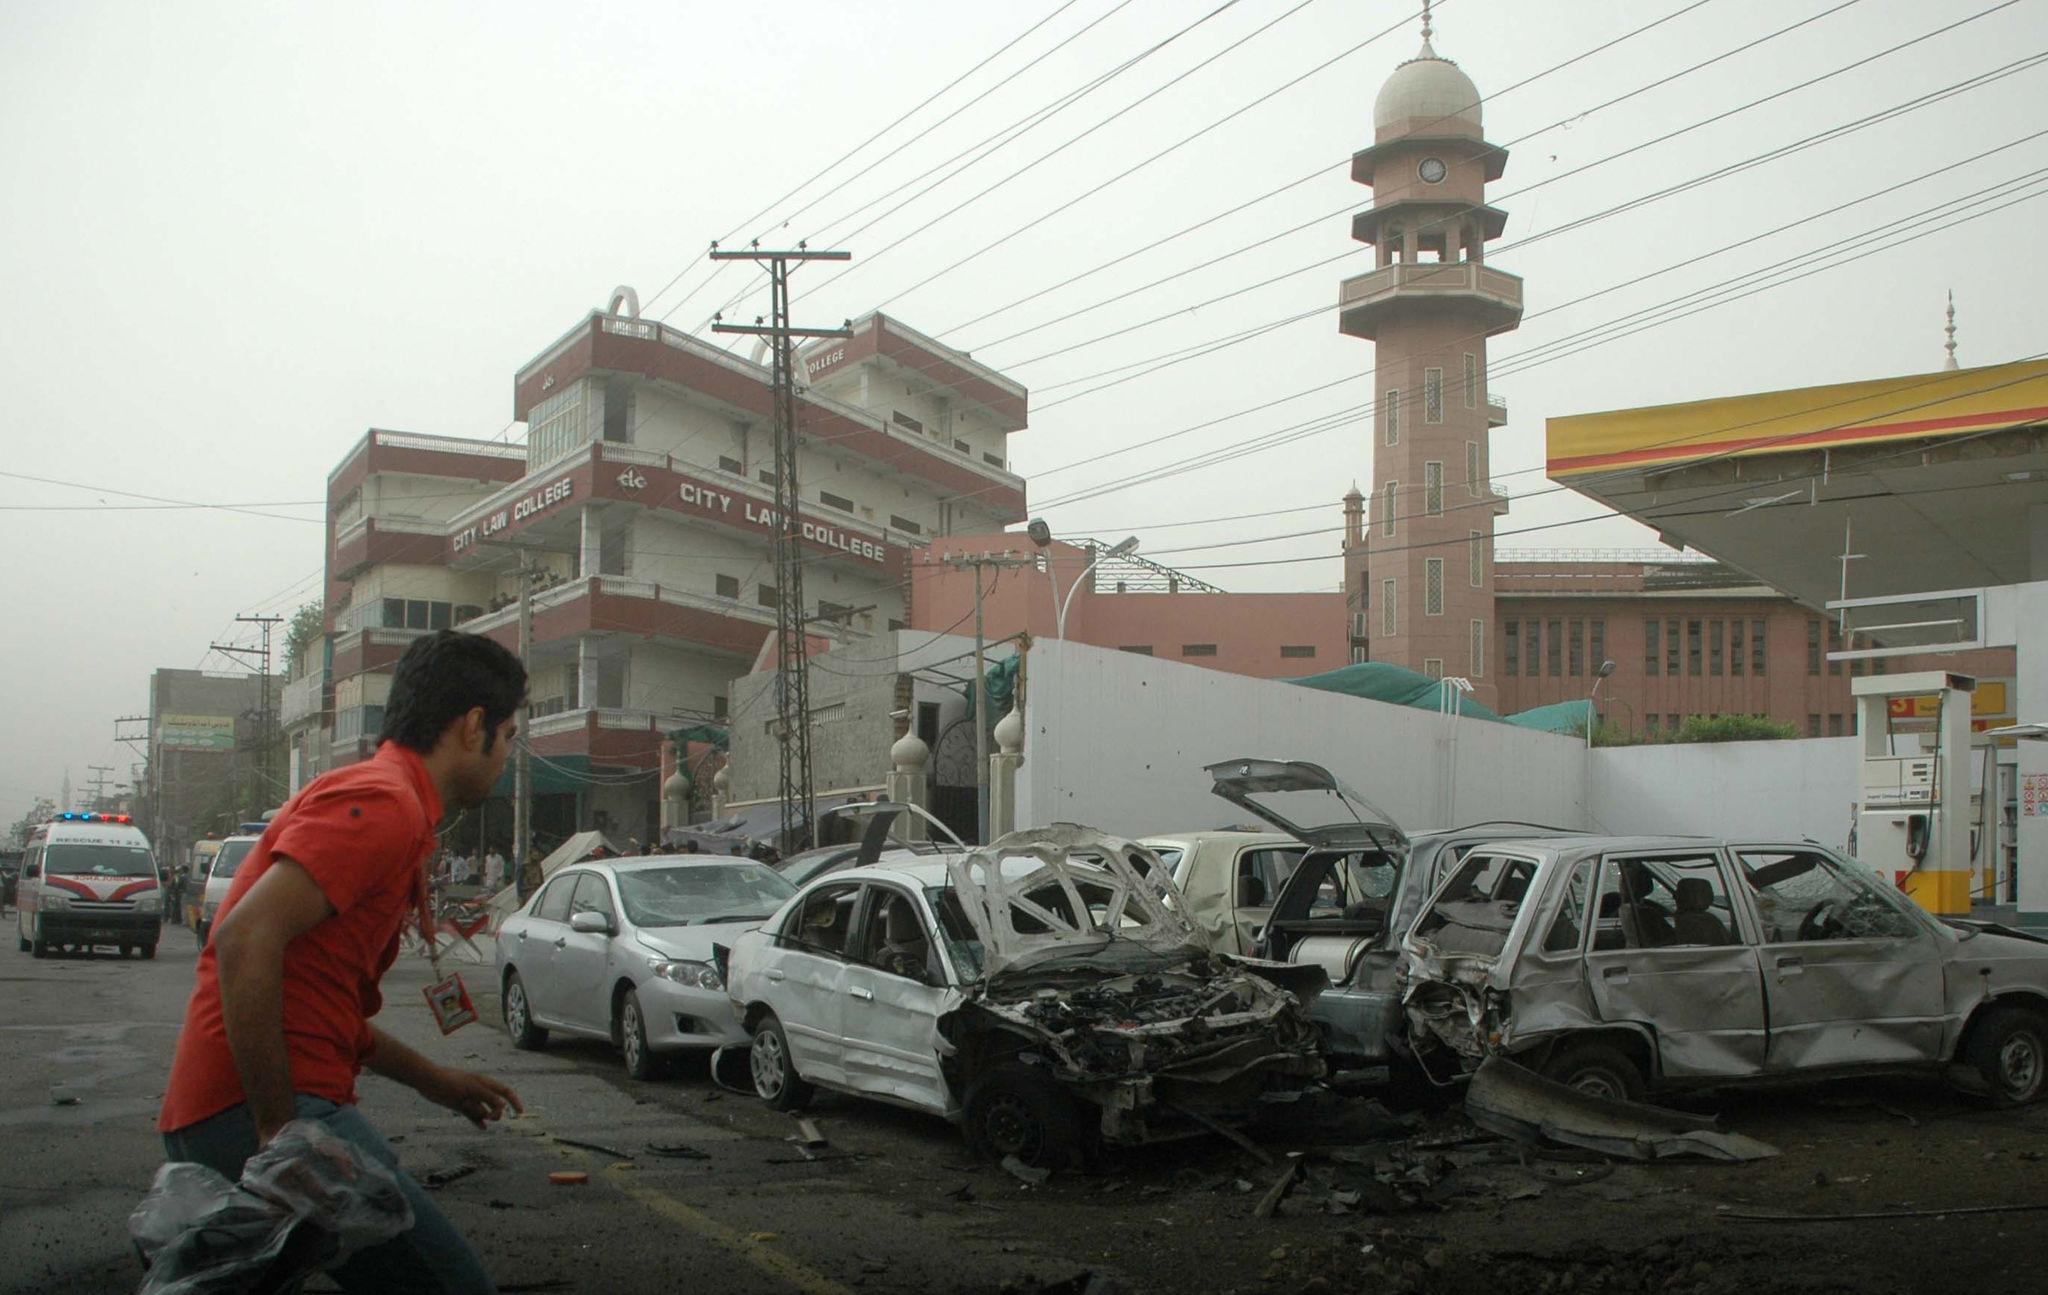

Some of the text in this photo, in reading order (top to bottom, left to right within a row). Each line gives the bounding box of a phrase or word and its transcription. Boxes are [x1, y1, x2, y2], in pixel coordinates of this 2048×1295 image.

[807, 348, 845, 374] OLLEGE
[453, 477, 572, 552] CITY LAW COLLEGE
[679, 482, 731, 513] CITY
[801, 521, 885, 563] COLLEGE
